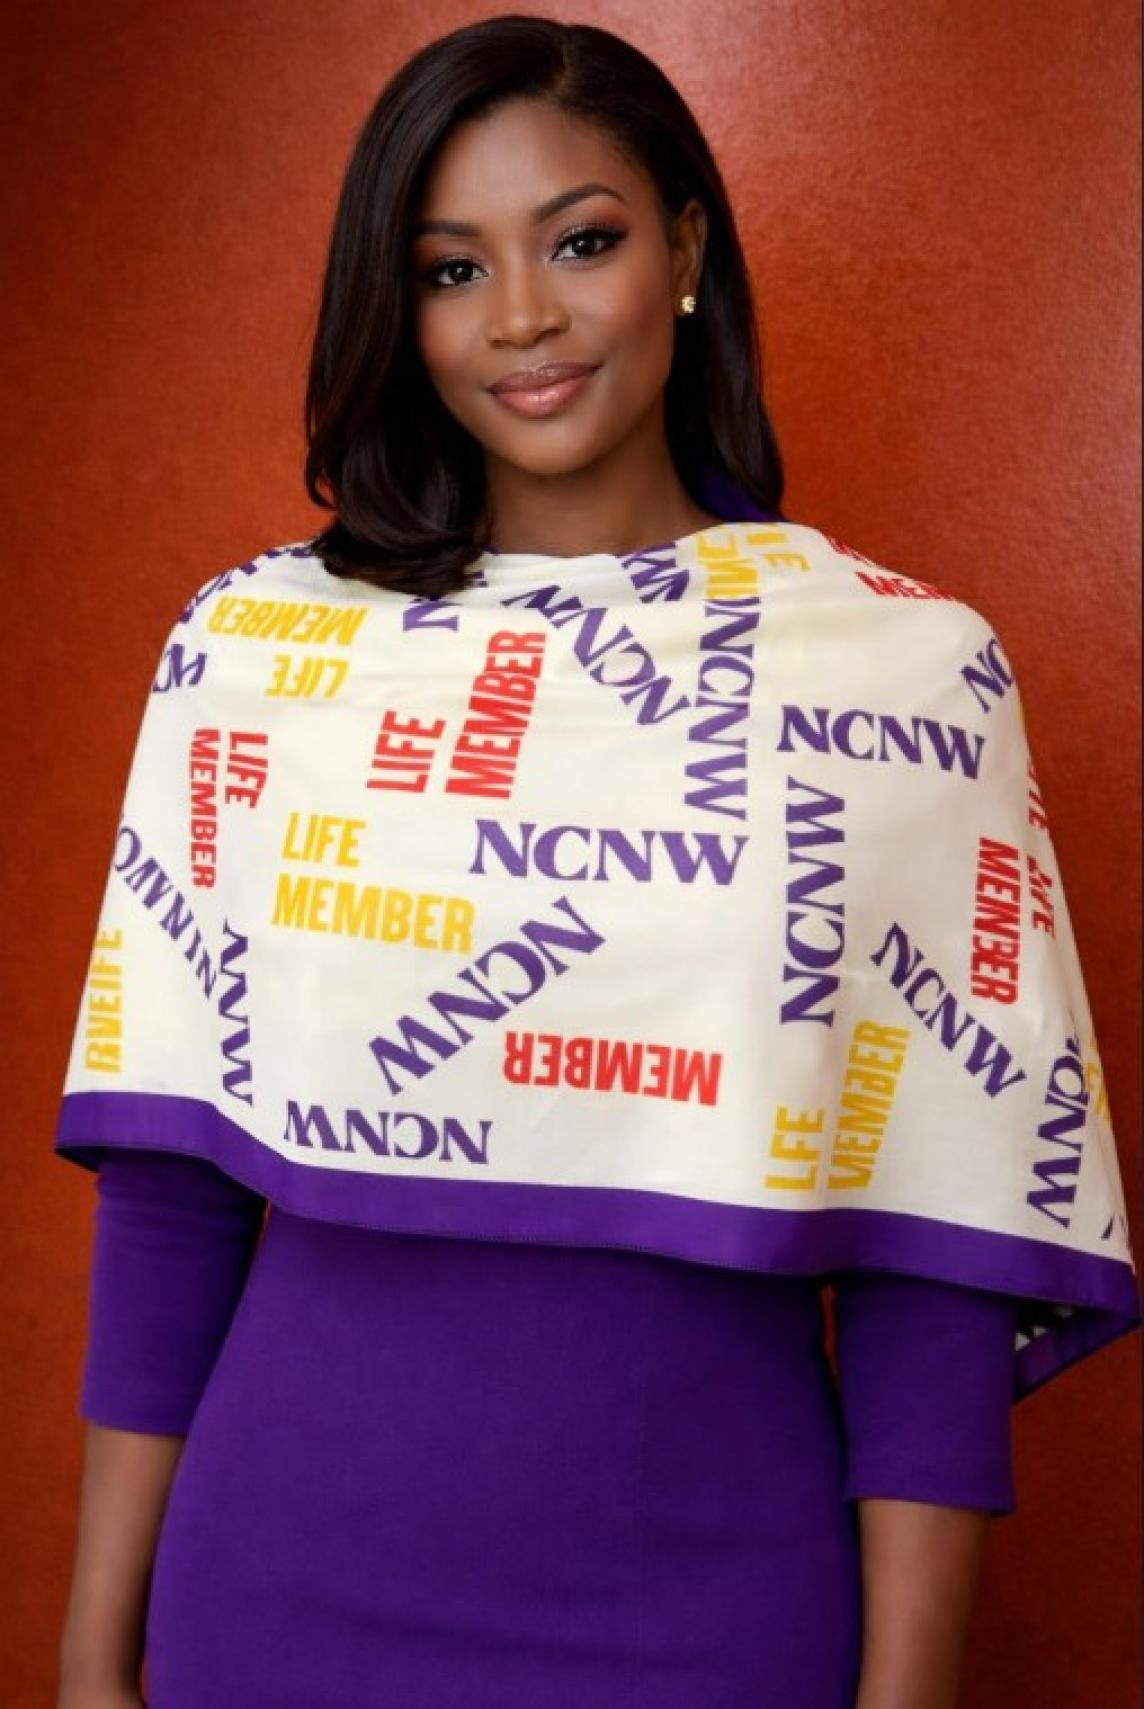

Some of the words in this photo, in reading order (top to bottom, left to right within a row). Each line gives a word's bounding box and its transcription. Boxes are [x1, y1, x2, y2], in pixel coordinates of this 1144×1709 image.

[206, 596, 368, 647] MEMBER
[266, 655, 349, 698] LIFE
[445, 630, 547, 800] MEMBER
[683, 605, 760, 822] NCNW
[225, 731, 268, 809] LIFE
[366, 710, 446, 793] LIFE
[777, 705, 985, 780] NCNW
[189, 729, 220, 888] MEMBER
[282, 812, 367, 868] LIFE
[468, 819, 749, 885] NCNW
[272, 873, 476, 955] MEMBER
[779, 775, 846, 1028] NCNW
[368, 896, 606, 1096] NCNW
[869, 921, 1027, 1099] NCNW
[503, 1030, 723, 1107] MEMBER
[283, 1100, 493, 1164] NCNW
